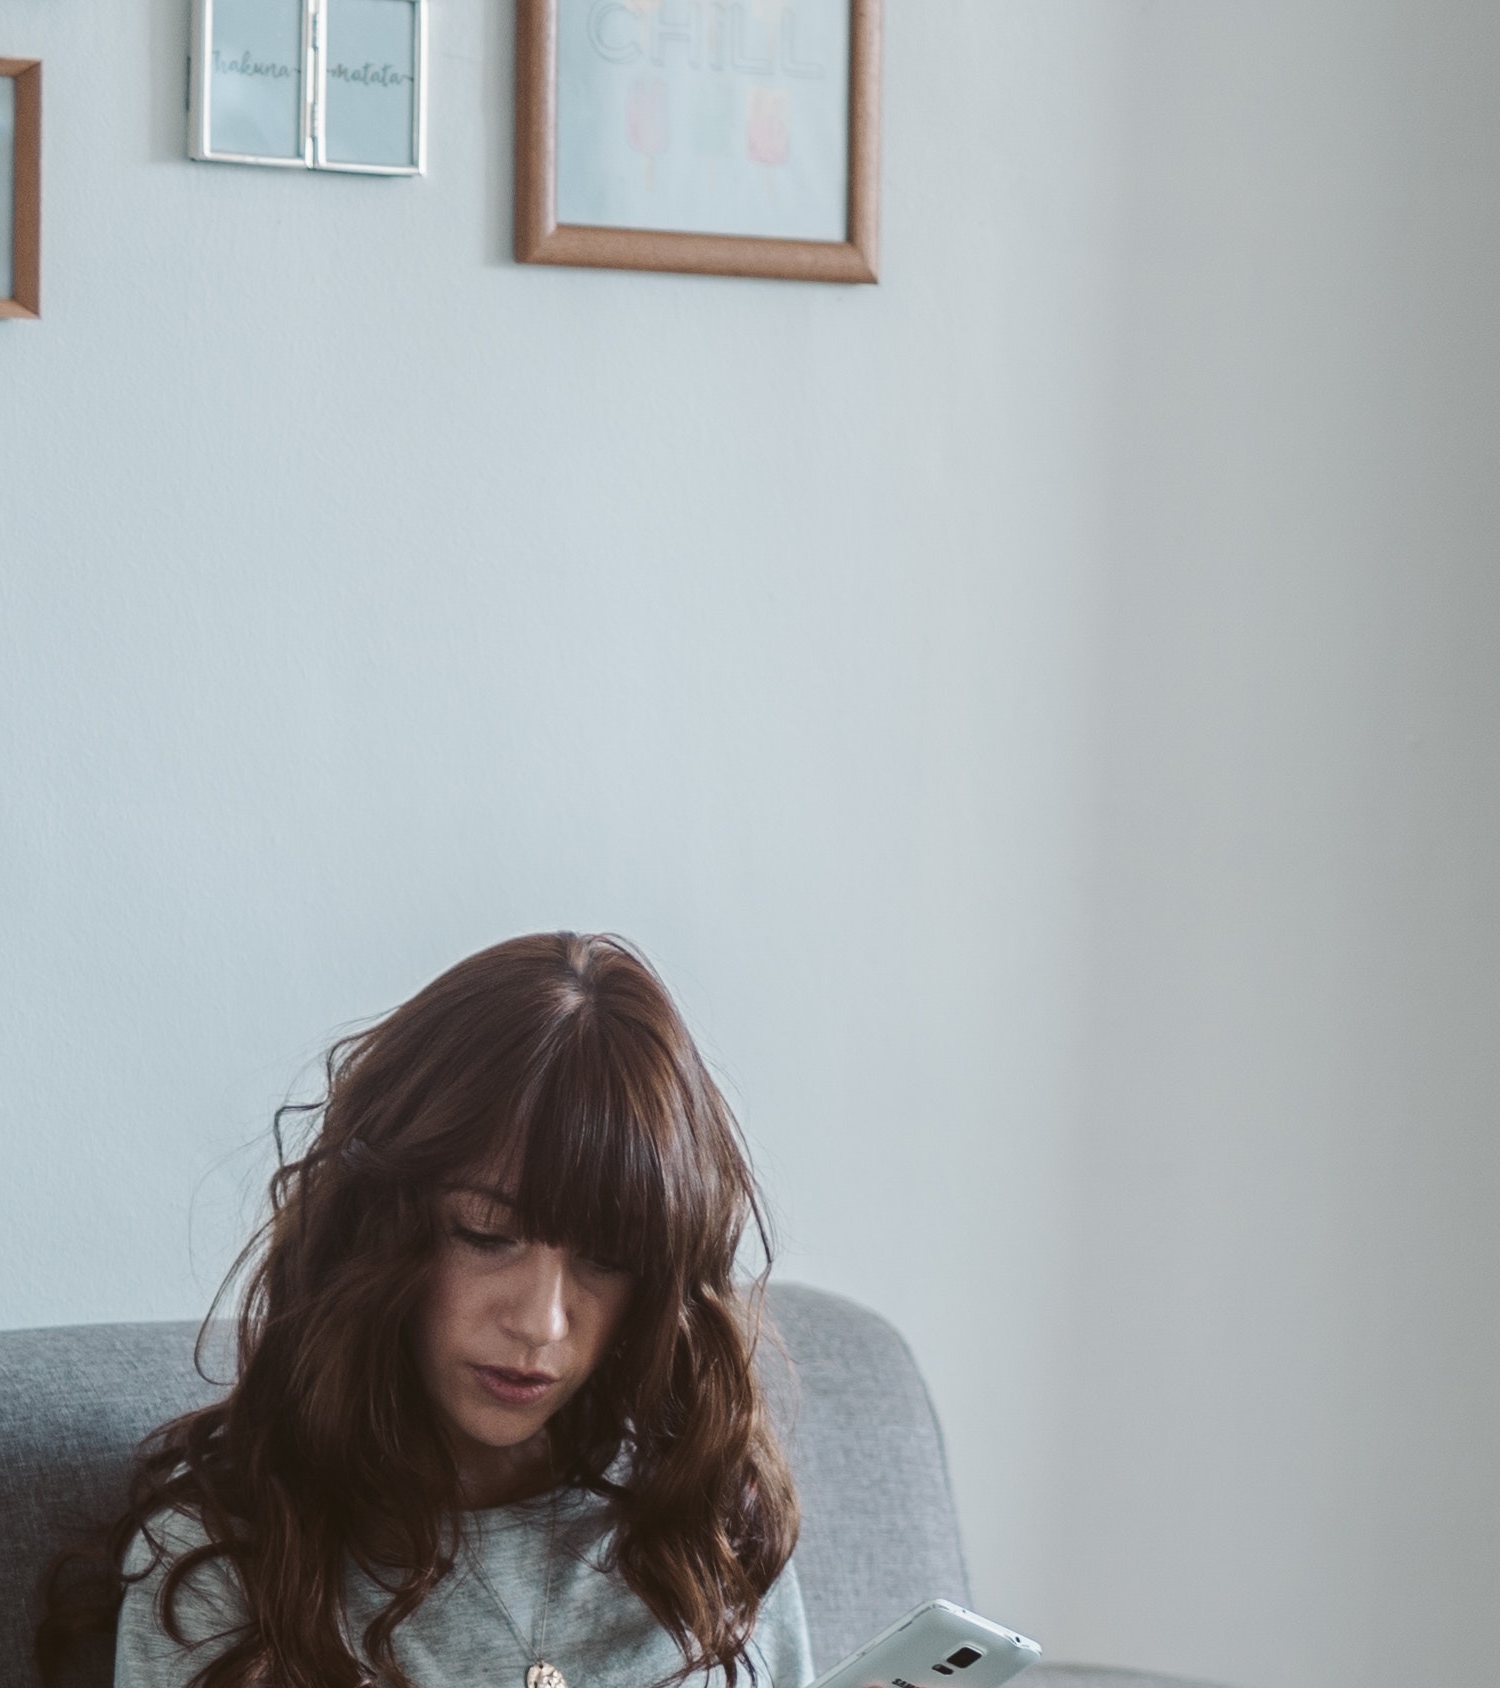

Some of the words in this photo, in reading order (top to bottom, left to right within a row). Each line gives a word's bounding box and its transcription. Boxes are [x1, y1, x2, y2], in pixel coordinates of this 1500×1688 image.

[212, 50, 299, 79] hakuna
[327, 63, 414, 87] matata
[587, 0, 826, 80] CHILL
